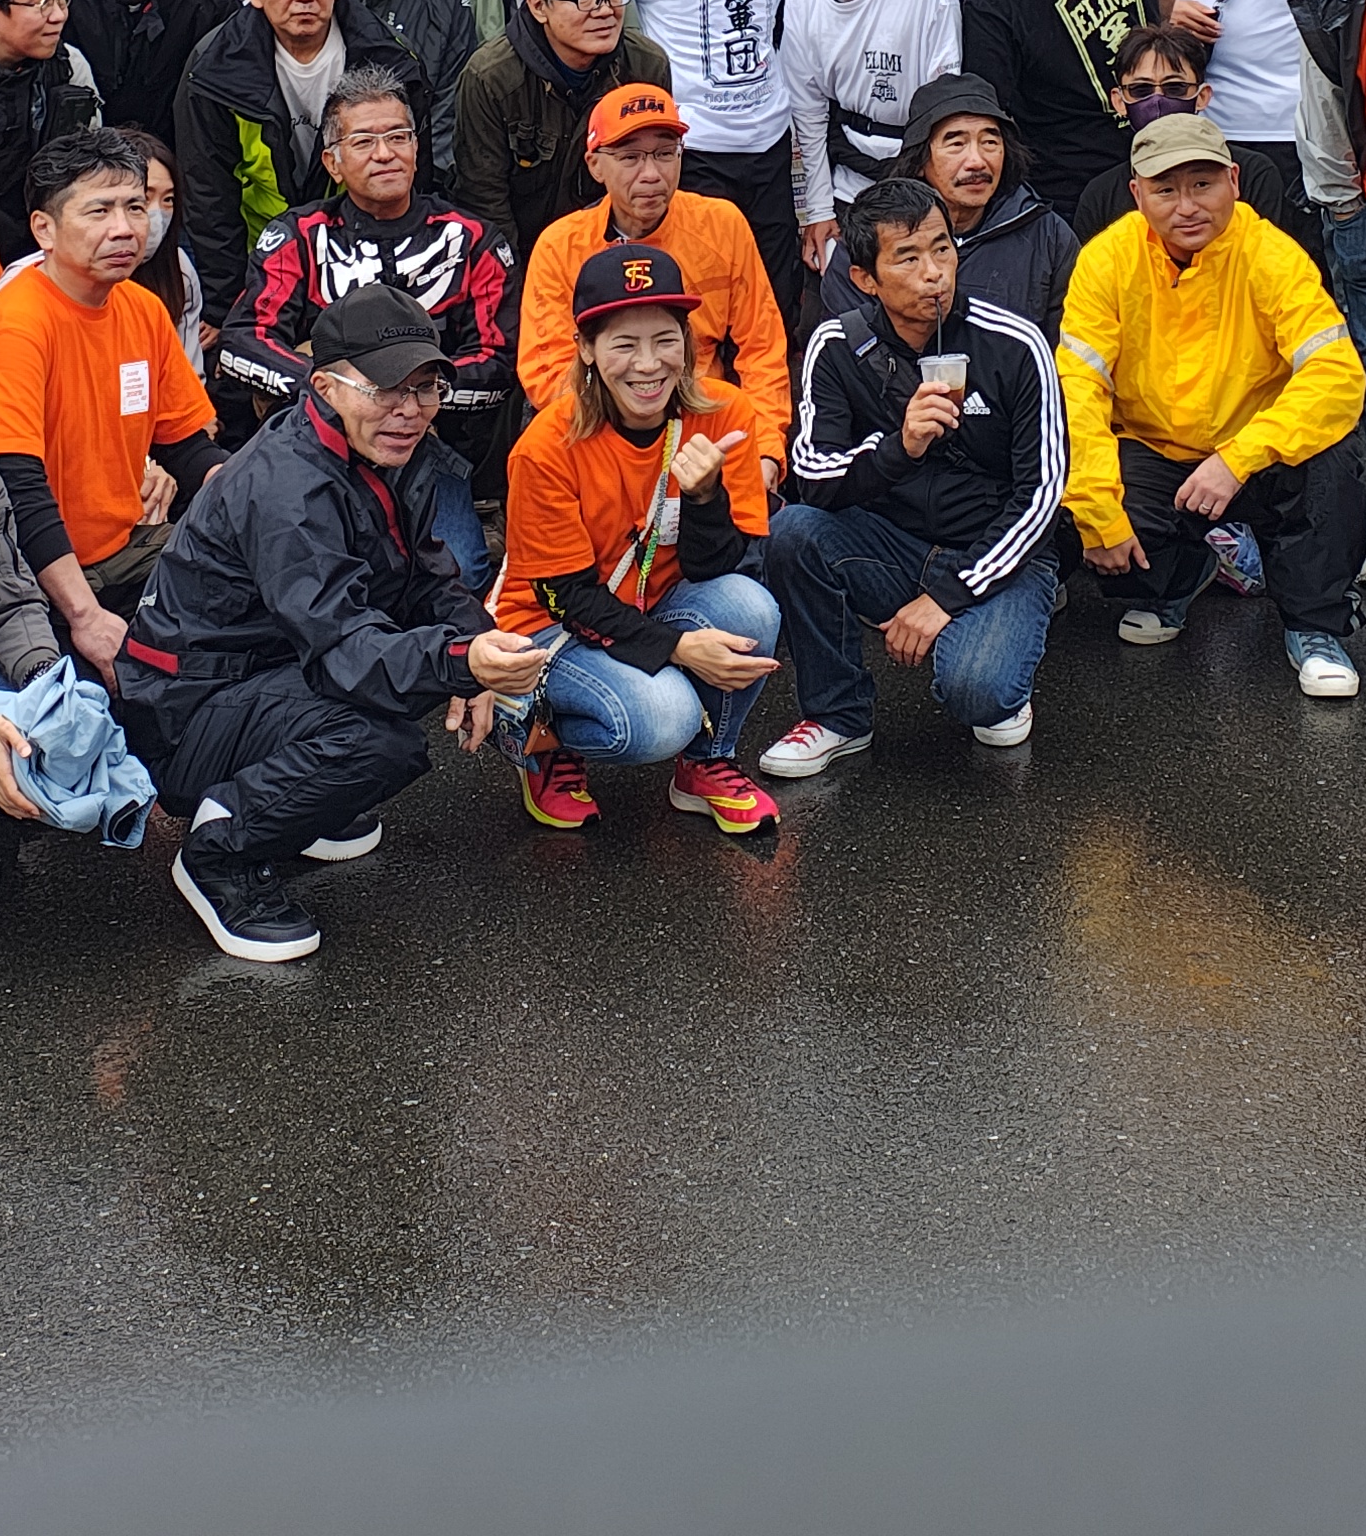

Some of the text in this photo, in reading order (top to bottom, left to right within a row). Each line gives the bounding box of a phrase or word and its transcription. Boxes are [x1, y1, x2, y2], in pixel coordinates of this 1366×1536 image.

[864, 50, 903, 74] ELIMI
[220, 349, 296, 394] BERIK
[963, 407, 992, 415] adidas
